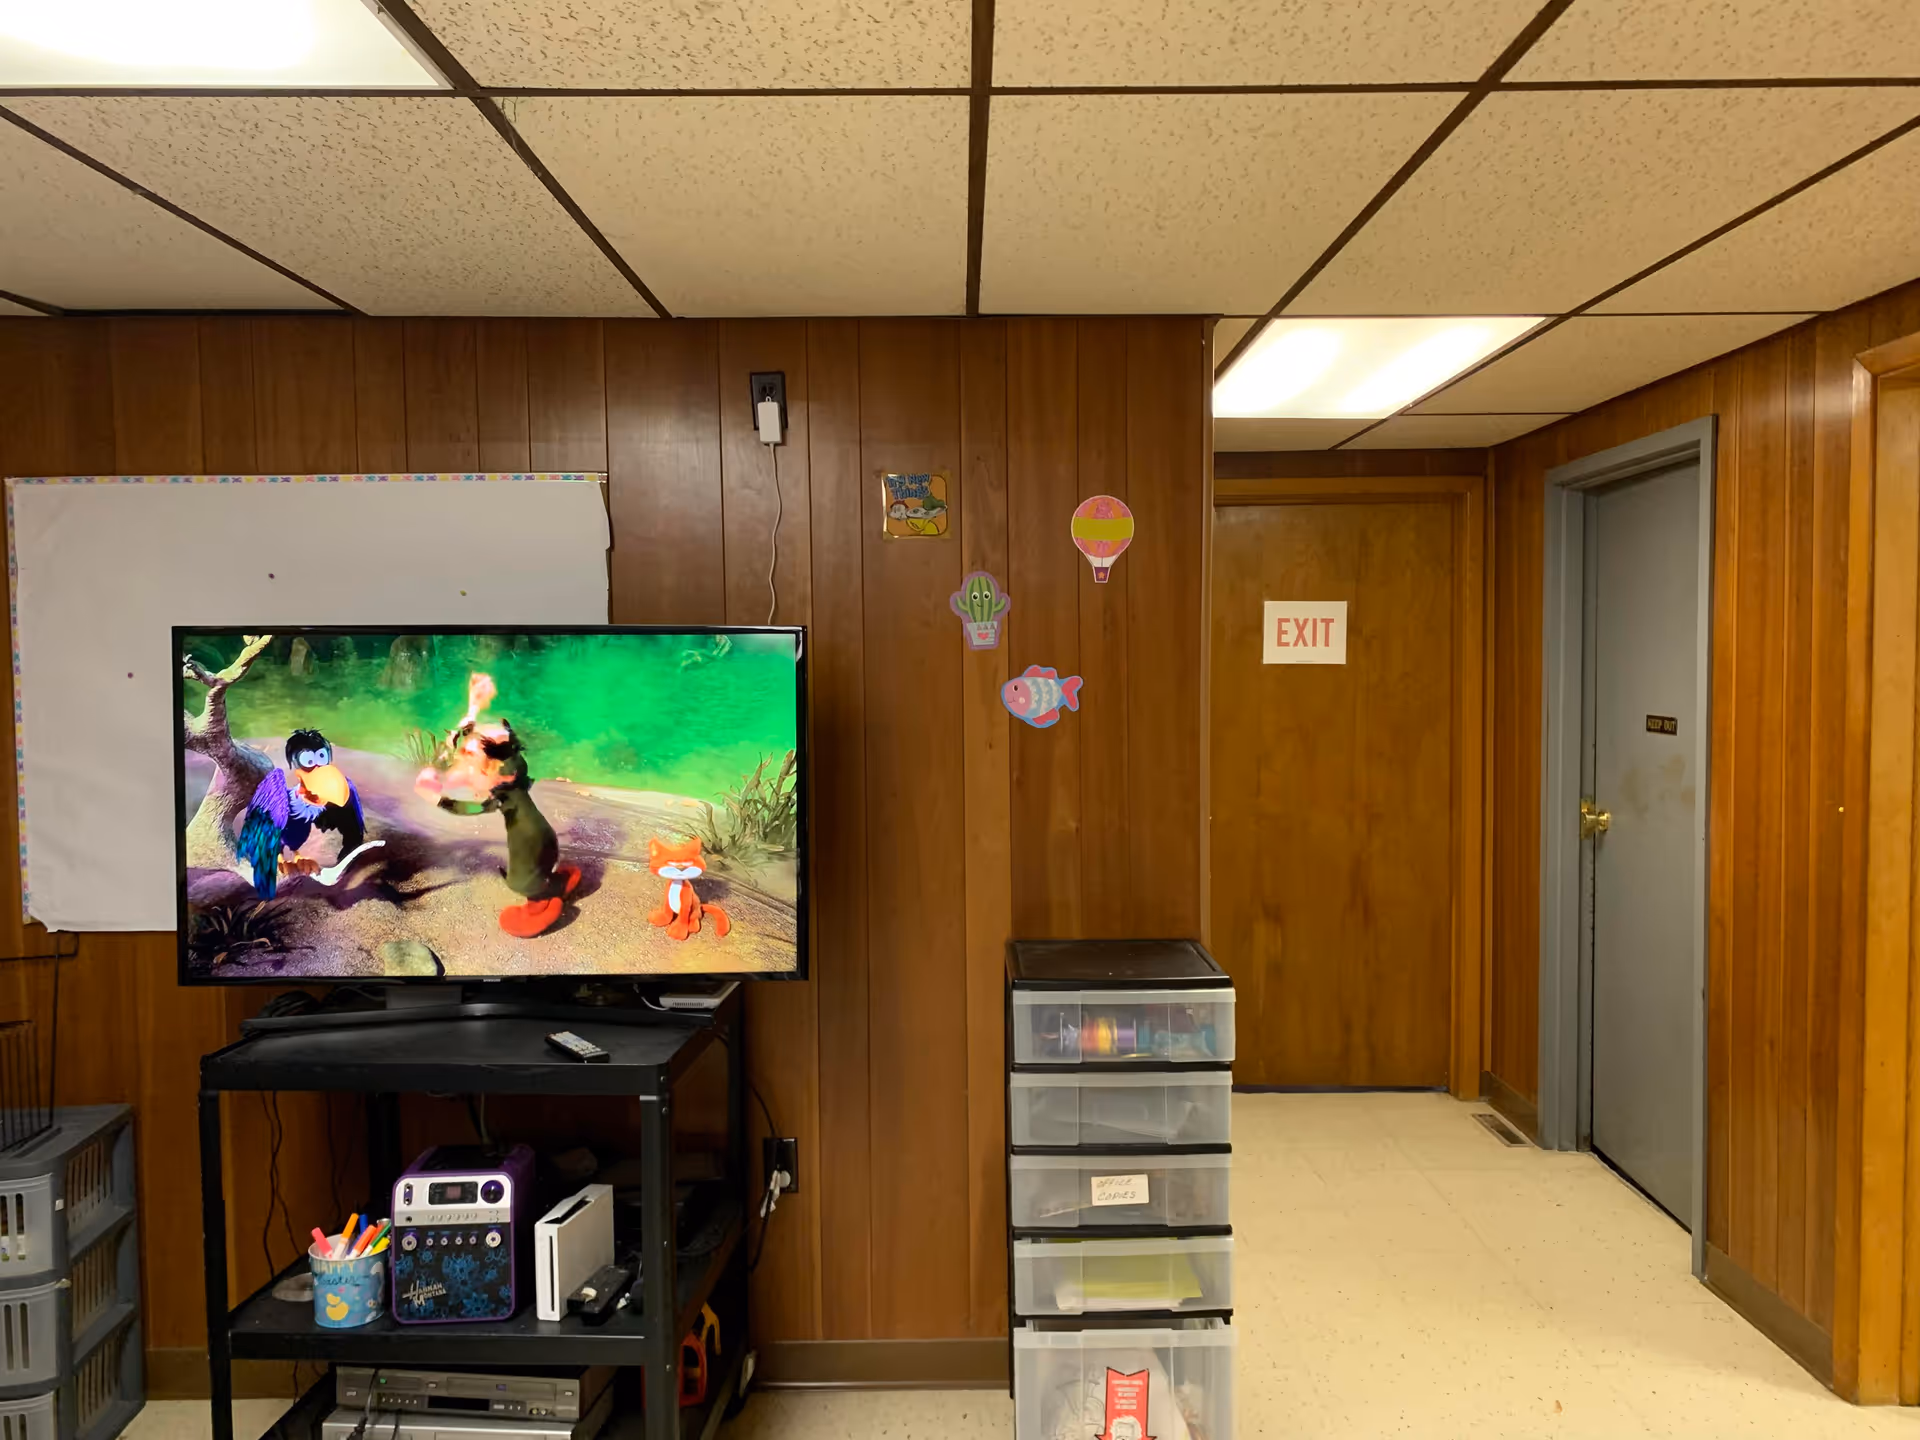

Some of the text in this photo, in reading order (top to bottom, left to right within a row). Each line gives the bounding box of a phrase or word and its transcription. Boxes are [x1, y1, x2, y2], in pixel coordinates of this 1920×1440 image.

[1276, 617, 1334, 648] EXIT
[1648, 719, 1675, 731] KEEP OUT
[1097, 1190, 1136, 1201] COPIES
